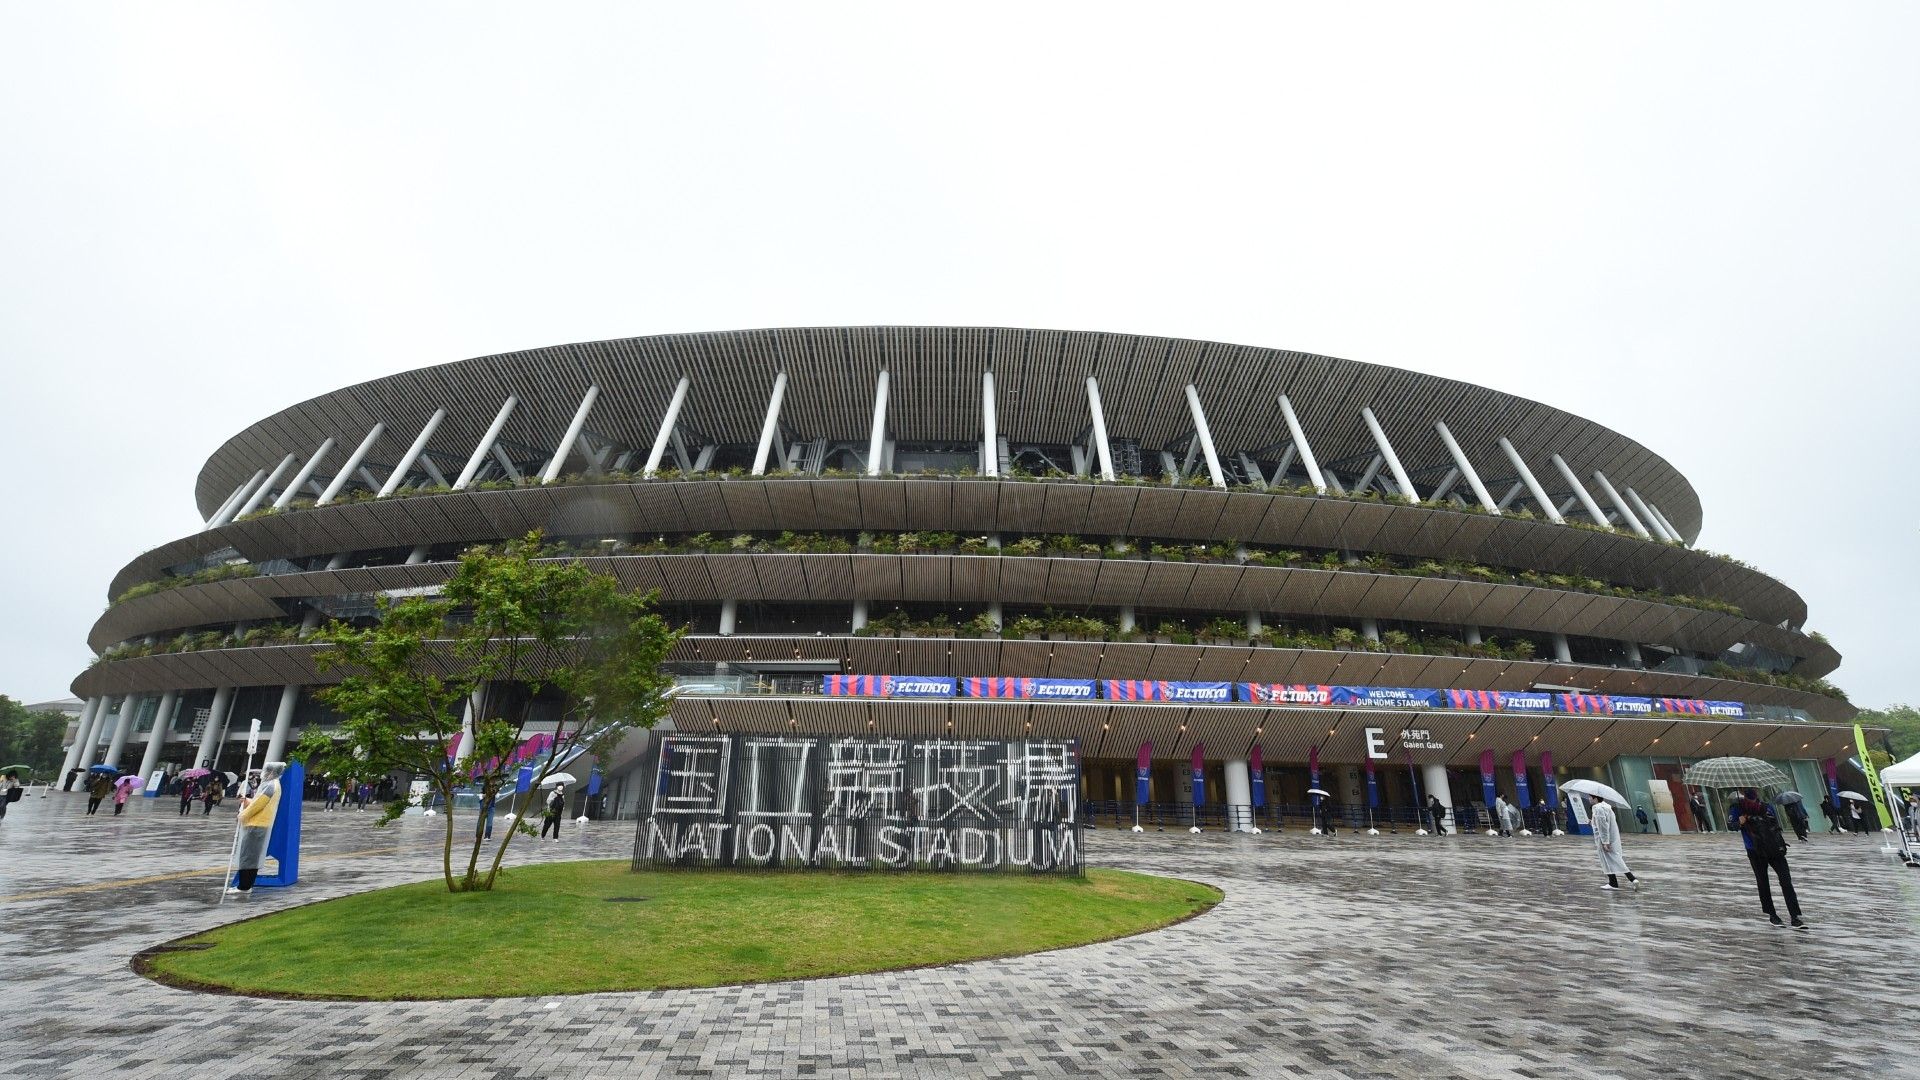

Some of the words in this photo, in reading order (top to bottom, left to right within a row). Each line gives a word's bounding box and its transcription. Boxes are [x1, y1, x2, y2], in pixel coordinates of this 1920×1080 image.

[1368, 690, 1407, 699] WELCOME
[1356, 698, 1373, 706] OUR
[1373, 699, 1396, 707] HOME
[1396, 699, 1430, 707] STADIUM
[1400, 729, 1430, 740] 外苑門
[1365, 727, 1388, 759] E
[1403, 741, 1425, 749] Gaien
[1426, 741, 1444, 749] Gate
[651, 735, 1076, 822] 国立競技場
[646, 817, 870, 867] NATIONAL
[878, 824, 1080, 871] STADIUM
